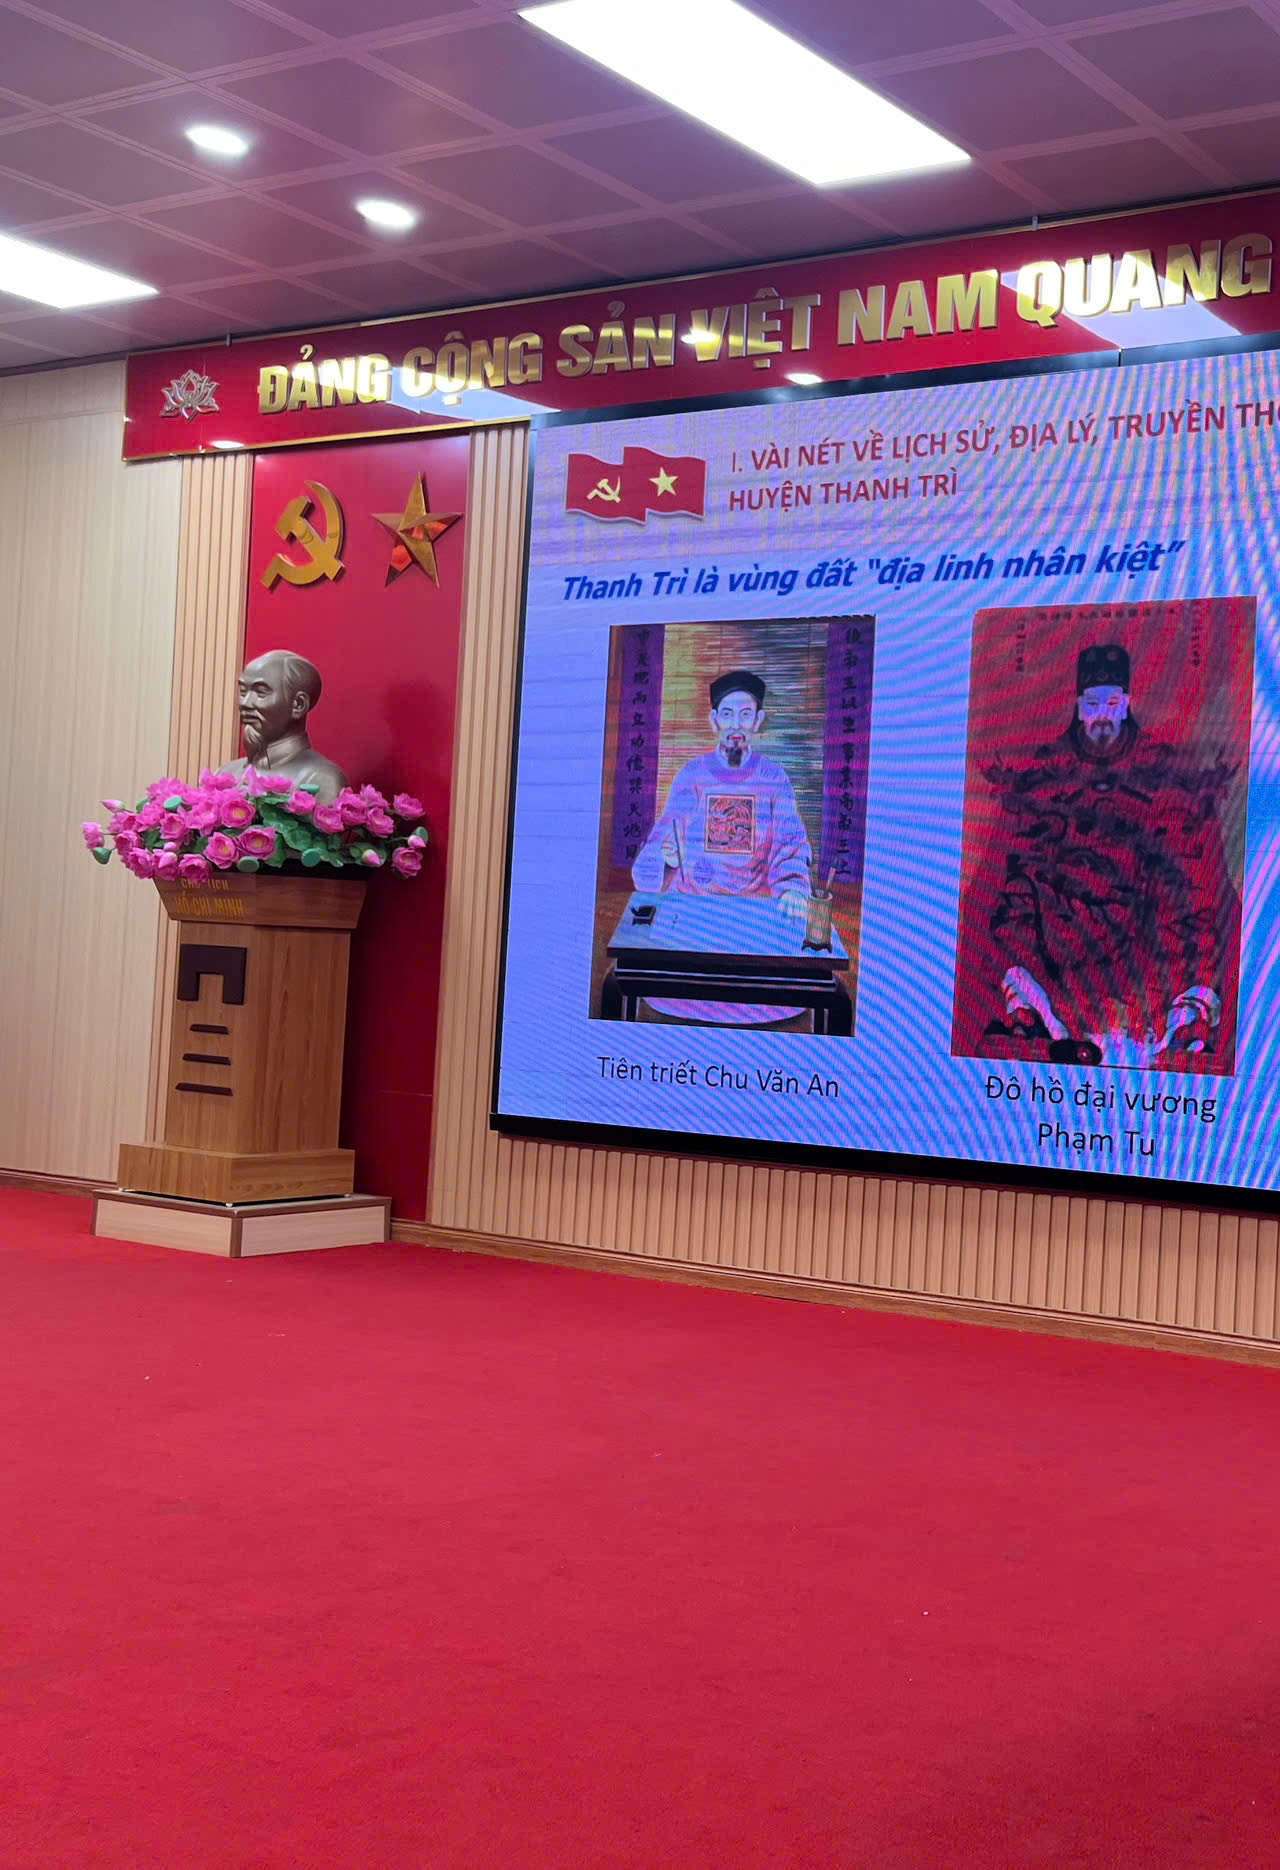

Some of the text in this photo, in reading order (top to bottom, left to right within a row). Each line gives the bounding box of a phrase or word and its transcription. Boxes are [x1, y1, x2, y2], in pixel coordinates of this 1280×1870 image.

[256, 344, 393, 415] ĐẢNG
[399, 331, 544, 405] CỘNG
[556, 300, 676, 379] SẢN
[689, 286, 821, 369] VIỆT
[838, 268, 999, 346] NAM
[1016, 232, 1273, 328] QUANG
[751, 443, 789, 472] VÀI
[798, 436, 846, 467] NÉT
[852, 429, 884, 462] VỀ
[892, 431, 947, 464] LỊCH
[956, 420, 1000, 457] SỬ,
[1009, 421, 1058, 454] ĐỊA
[1067, 412, 1098, 447] LÝ,
[1109, 399, 1226, 441] TRUYỀN
[729, 467, 959, 512] HUYỆN THANH TRÌ
[562, 573, 642, 601] Thanh
[652, 568, 689, 596] Trì
[693, 565, 719, 594] là
[728, 563, 799, 597] vùng
[806, 557, 858, 589] đất
[934, 552, 994, 581] linh
[1002, 545, 1086, 579] nhân
[597, 1056, 840, 1098] Tiên triết Chu Văn An
[985, 1075, 1217, 1124] Đô hồ đại vương
[1038, 1122, 1156, 1156] Phạm Tu
